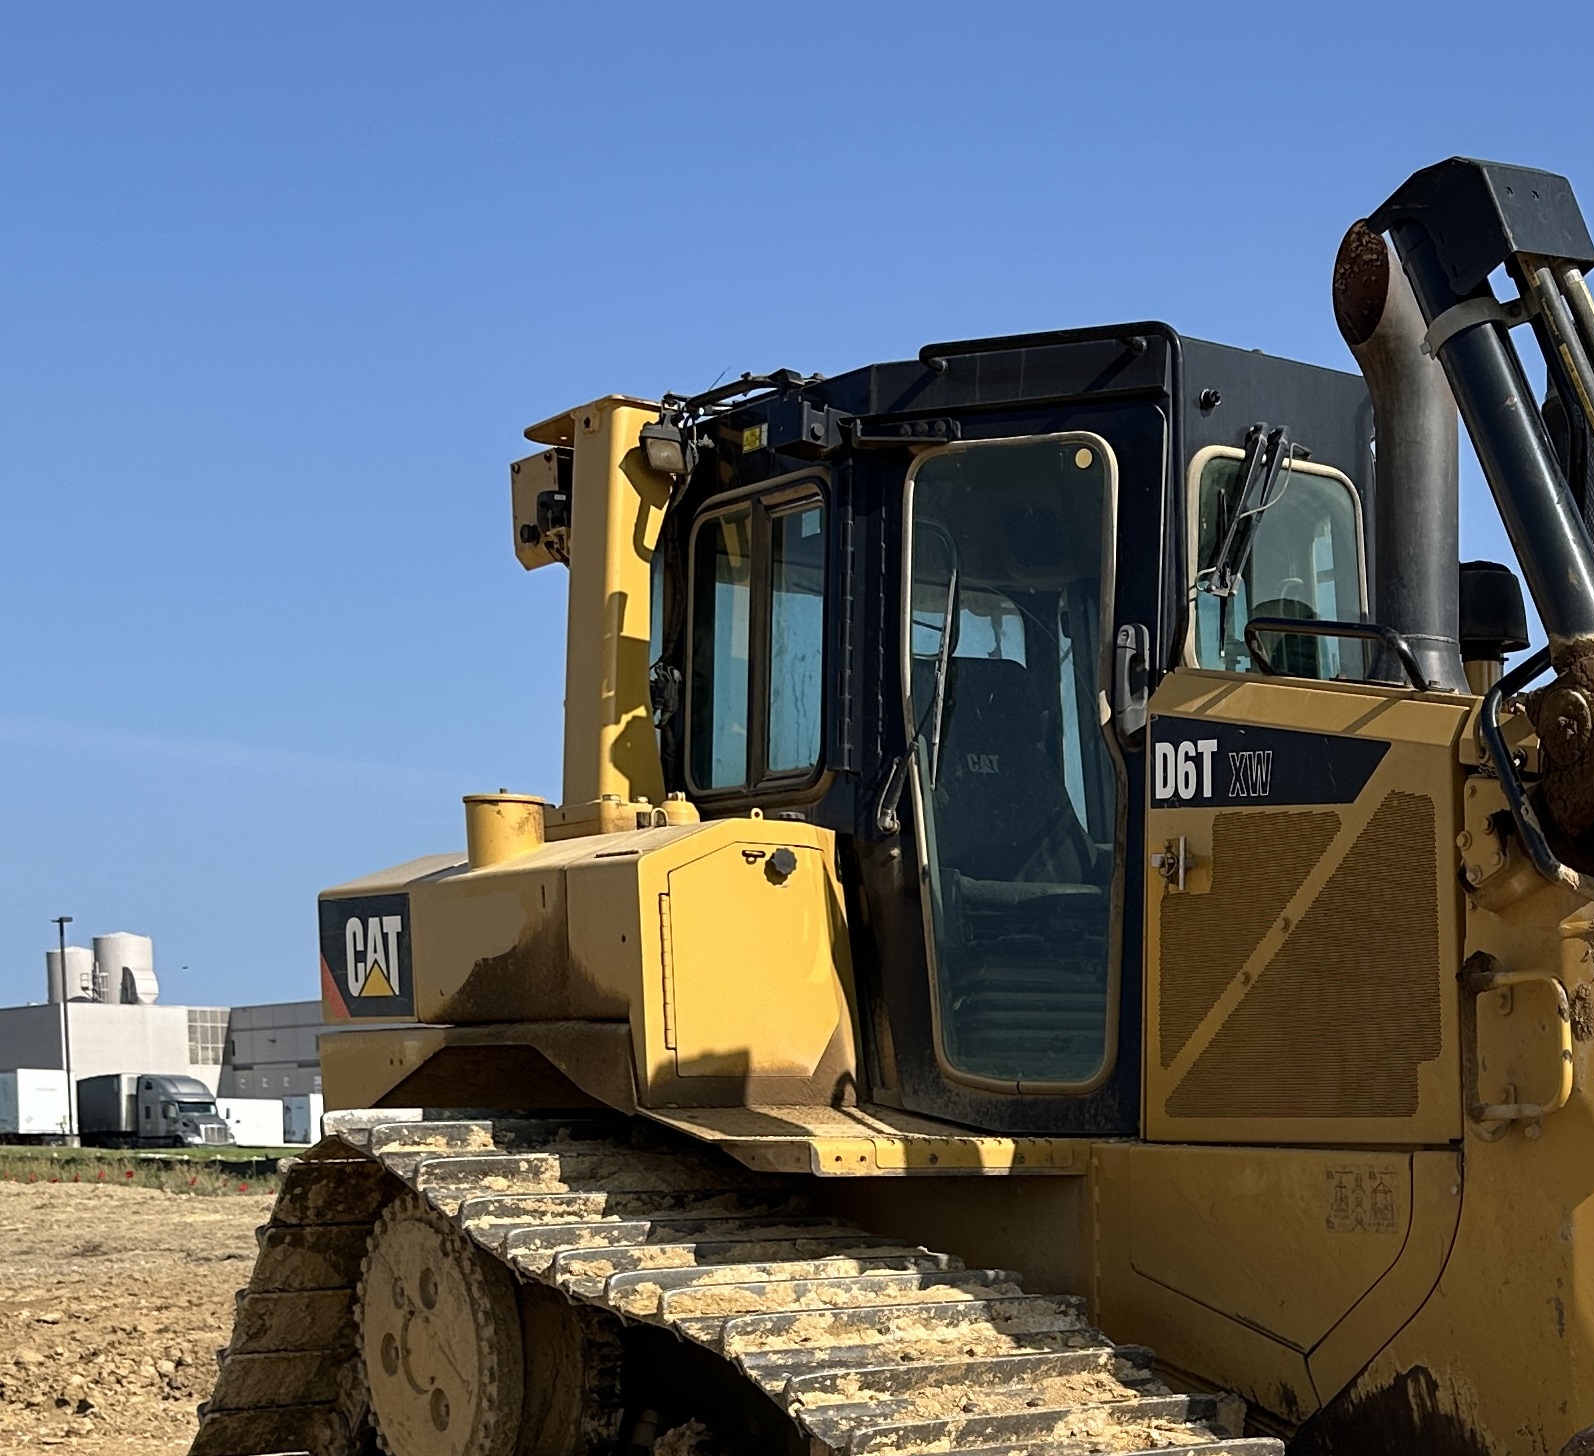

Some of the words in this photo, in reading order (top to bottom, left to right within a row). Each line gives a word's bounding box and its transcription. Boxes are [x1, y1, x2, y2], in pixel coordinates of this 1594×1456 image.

[966, 753, 1000, 773] CAT
[1155, 739, 1218, 800] D6T
[1228, 750, 1273, 797] XW
[345, 915, 402, 997] CAT
